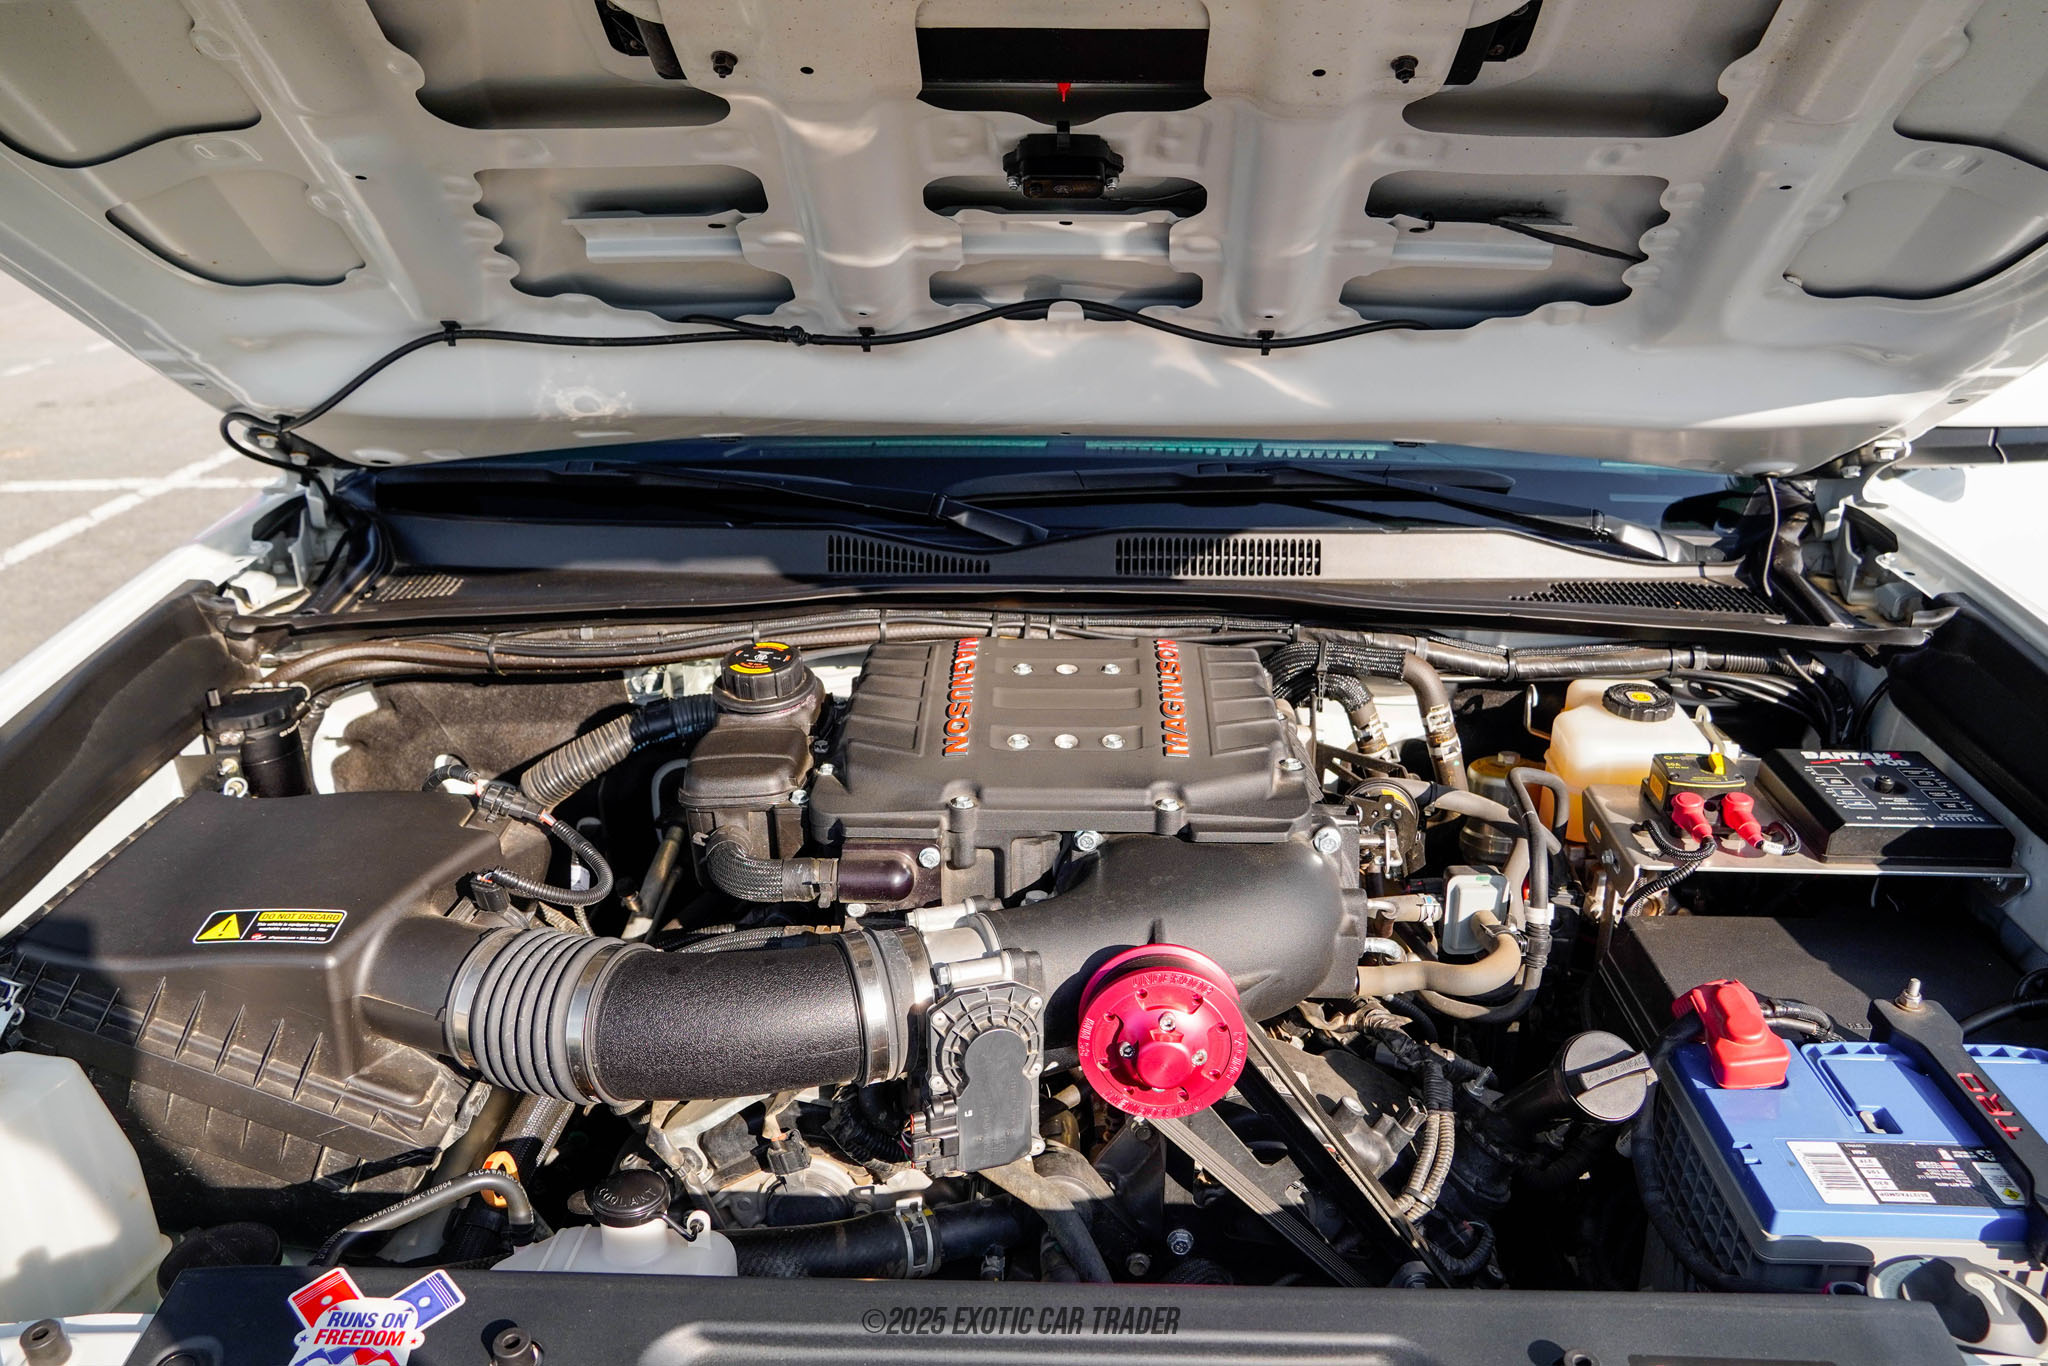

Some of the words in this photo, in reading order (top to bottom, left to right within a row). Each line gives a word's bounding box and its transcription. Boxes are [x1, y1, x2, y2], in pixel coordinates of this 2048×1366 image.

[944, 637, 979, 757] MAGNUSON
[1153, 639, 1190, 758] MAGNUSON
[298, 913, 340, 921] DISCARD
[1956, 1072, 2023, 1140] TRD
[598, 1187, 657, 1208] COOLANT
[327, 1312, 380, 1328] RUNS
[382, 1312, 409, 1328] ON
[313, 1329, 406, 1346] FREEDOM
